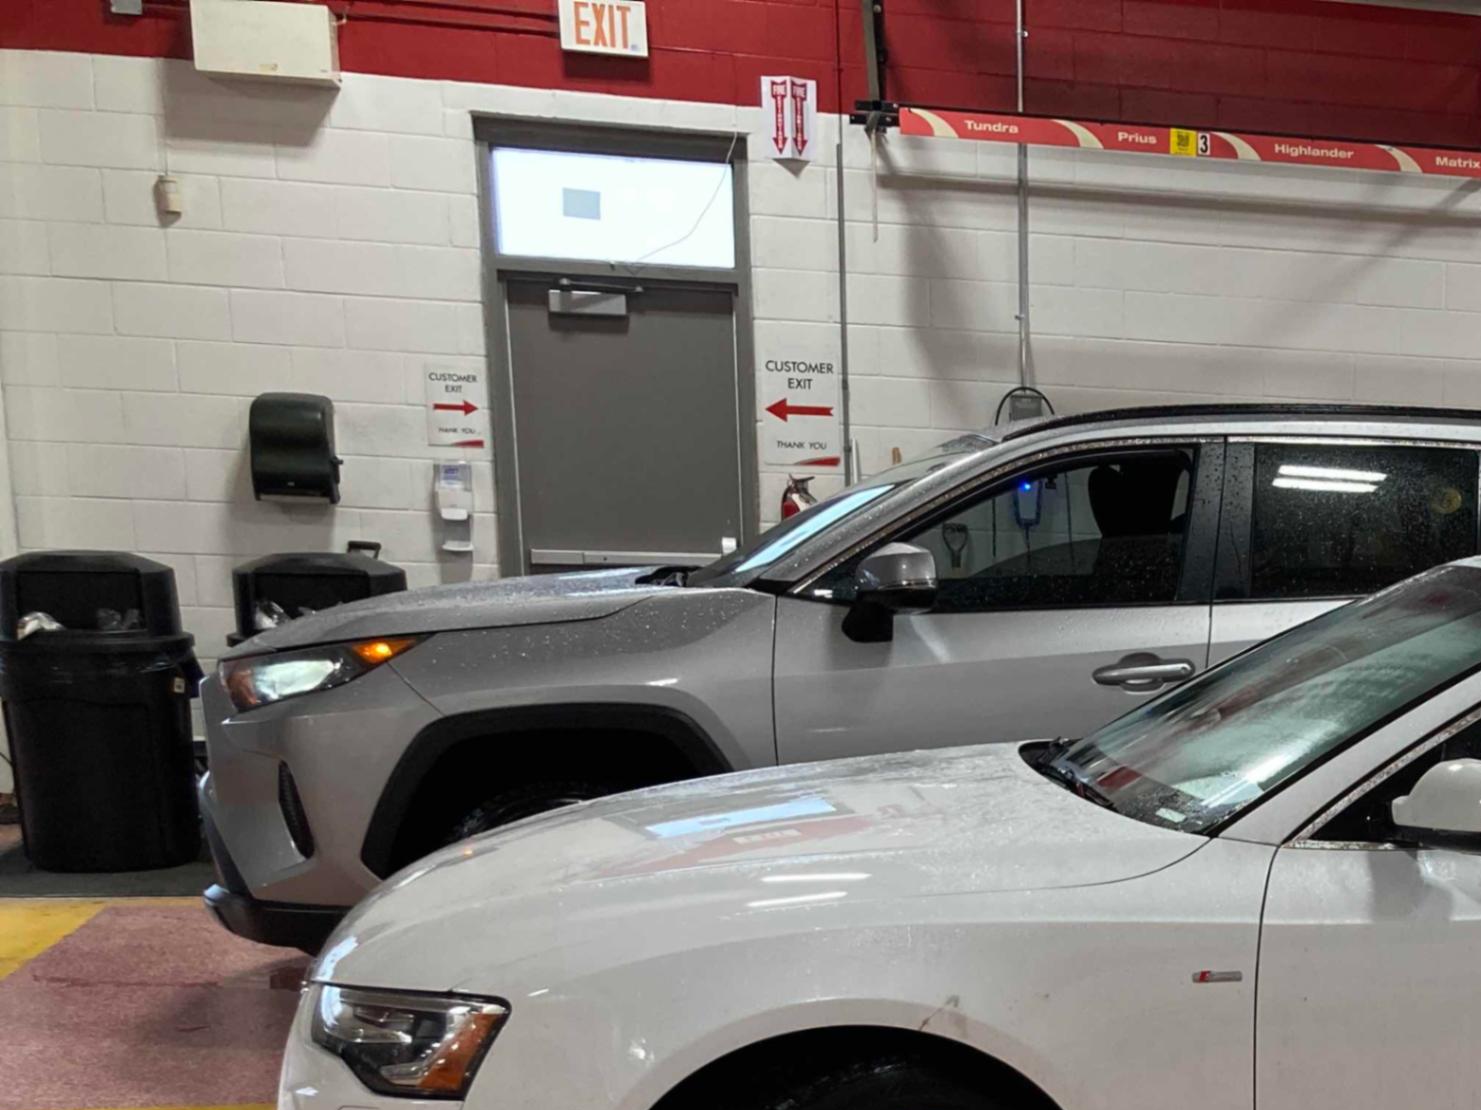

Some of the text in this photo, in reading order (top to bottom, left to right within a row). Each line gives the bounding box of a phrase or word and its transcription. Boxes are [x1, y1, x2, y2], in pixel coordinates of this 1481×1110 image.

[574, 1, 631, 49] EXIT
[964, 119, 1019, 134] Tundra
[1117, 131, 1157, 144] Prius
[1199, 134, 1209, 154] 3
[1274, 143, 1354, 160] Highlander
[1435, 156, 1481, 169] Matrix
[765, 360, 833, 375] CUSTOMER
[428, 372, 477, 383] CUSTOMER
[787, 377, 812, 390] EXIT
[445, 384, 462, 393] EXIT
[438, 426, 458, 434] THANK
[777, 440, 827, 450] THANK YOU
